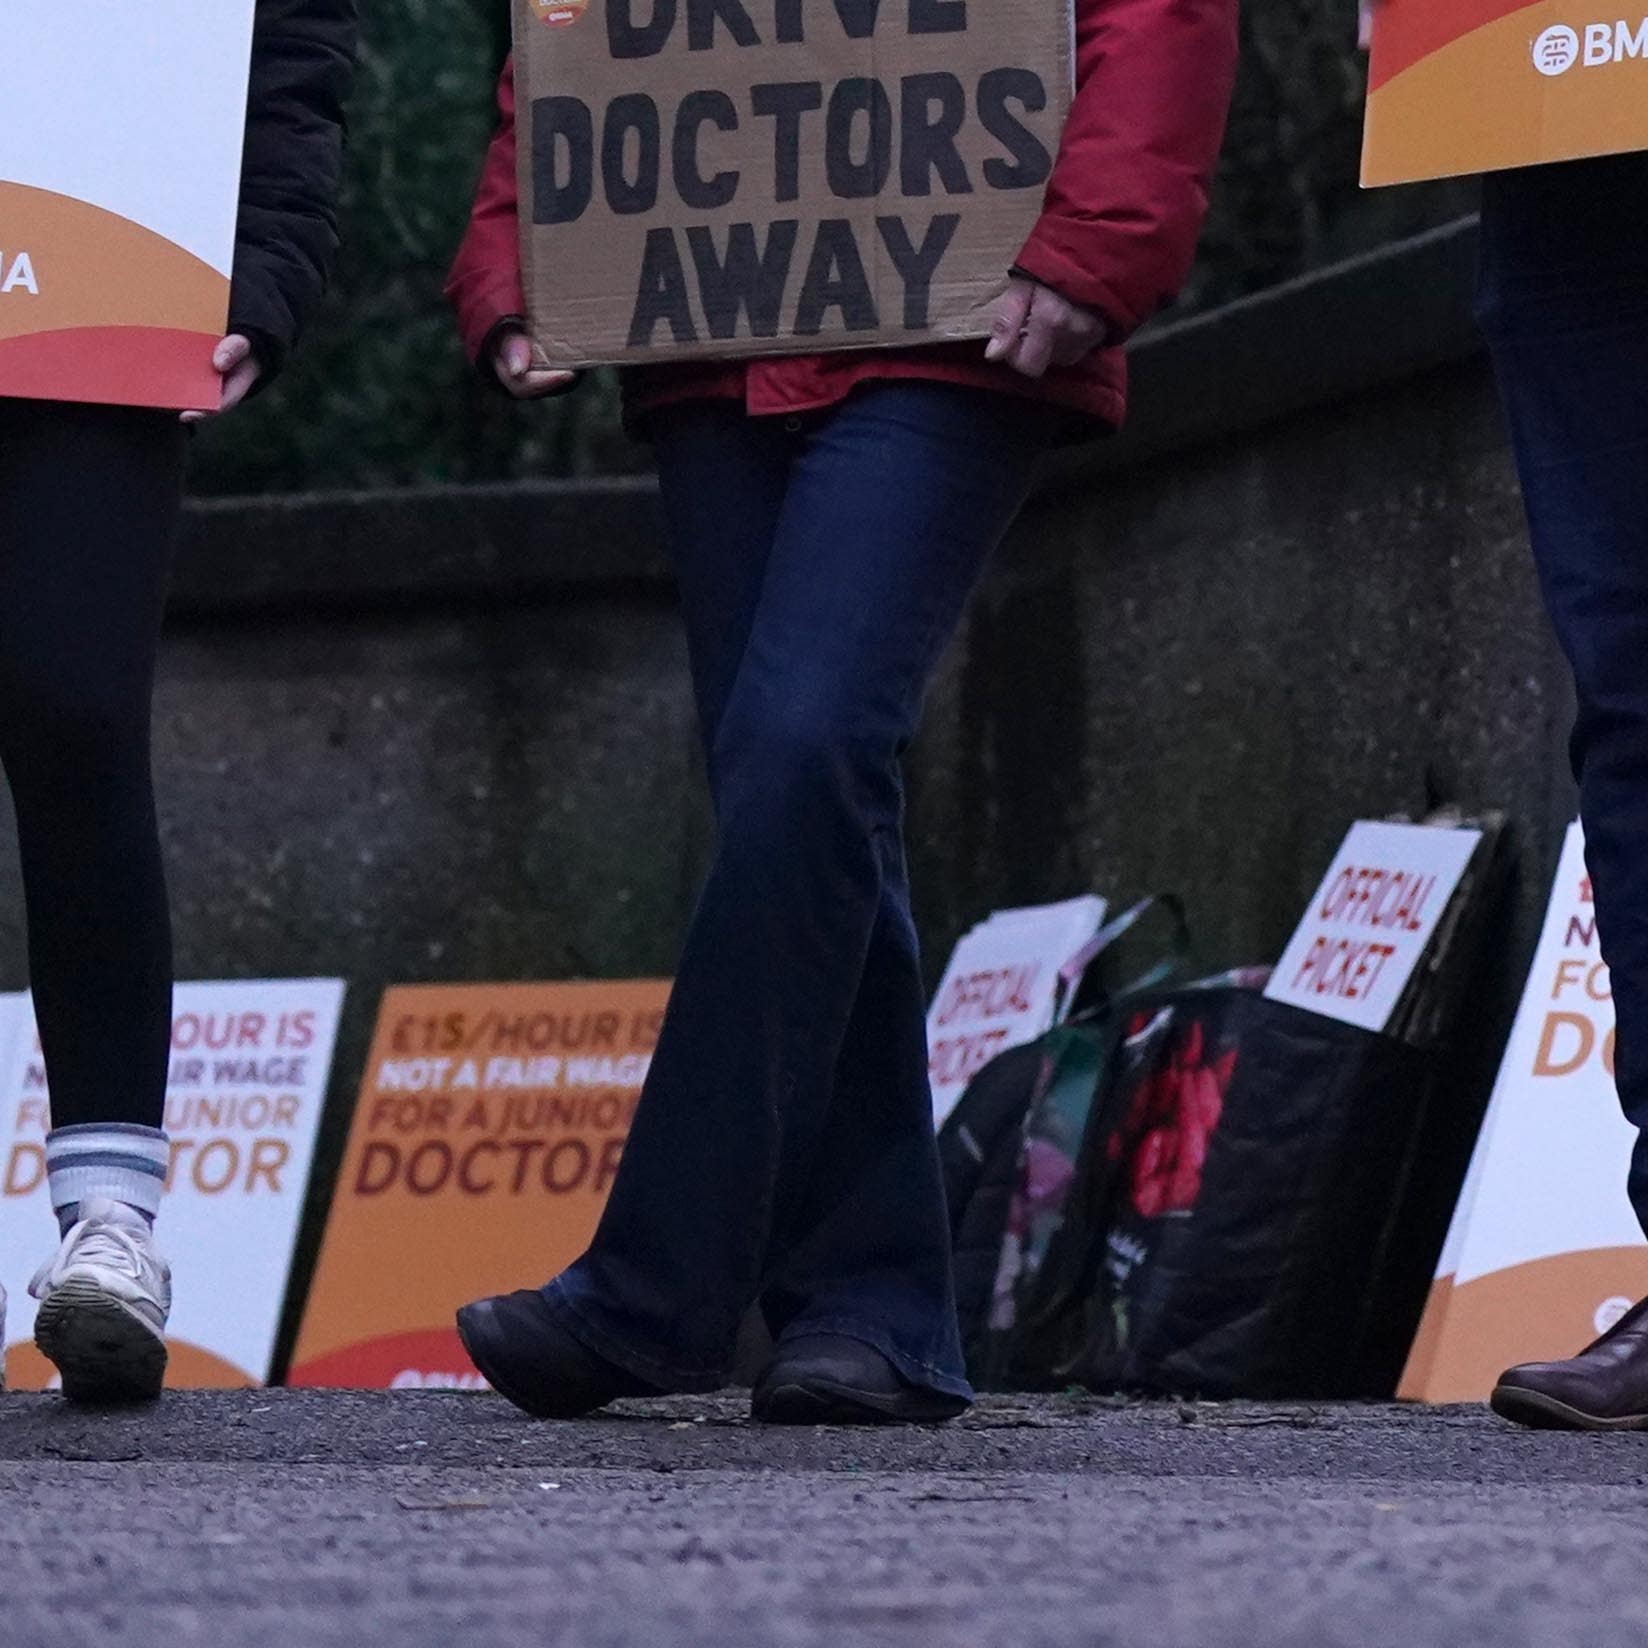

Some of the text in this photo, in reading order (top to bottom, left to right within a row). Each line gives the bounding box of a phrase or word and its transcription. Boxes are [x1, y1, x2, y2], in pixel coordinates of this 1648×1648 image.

[530, 67, 1053, 224] DOCTORS
[627, 212, 961, 347] AWAY
[1319, 867, 1438, 931] OFFICIAL
[1290, 937, 1396, 1000] PICKET
[275, 1011, 316, 1049] IS
[392, 1011, 619, 1052] £15/HOUR
[213, 1054, 307, 1085] WAGE
[376, 1056, 451, 1091] NOT
[451, 1058, 478, 1090] A
[482, 1055, 562, 1090] FAIR
[163, 1094, 300, 1131] UNIOR
[368, 1095, 451, 1132] FOR
[461, 1098, 488, 1132] A
